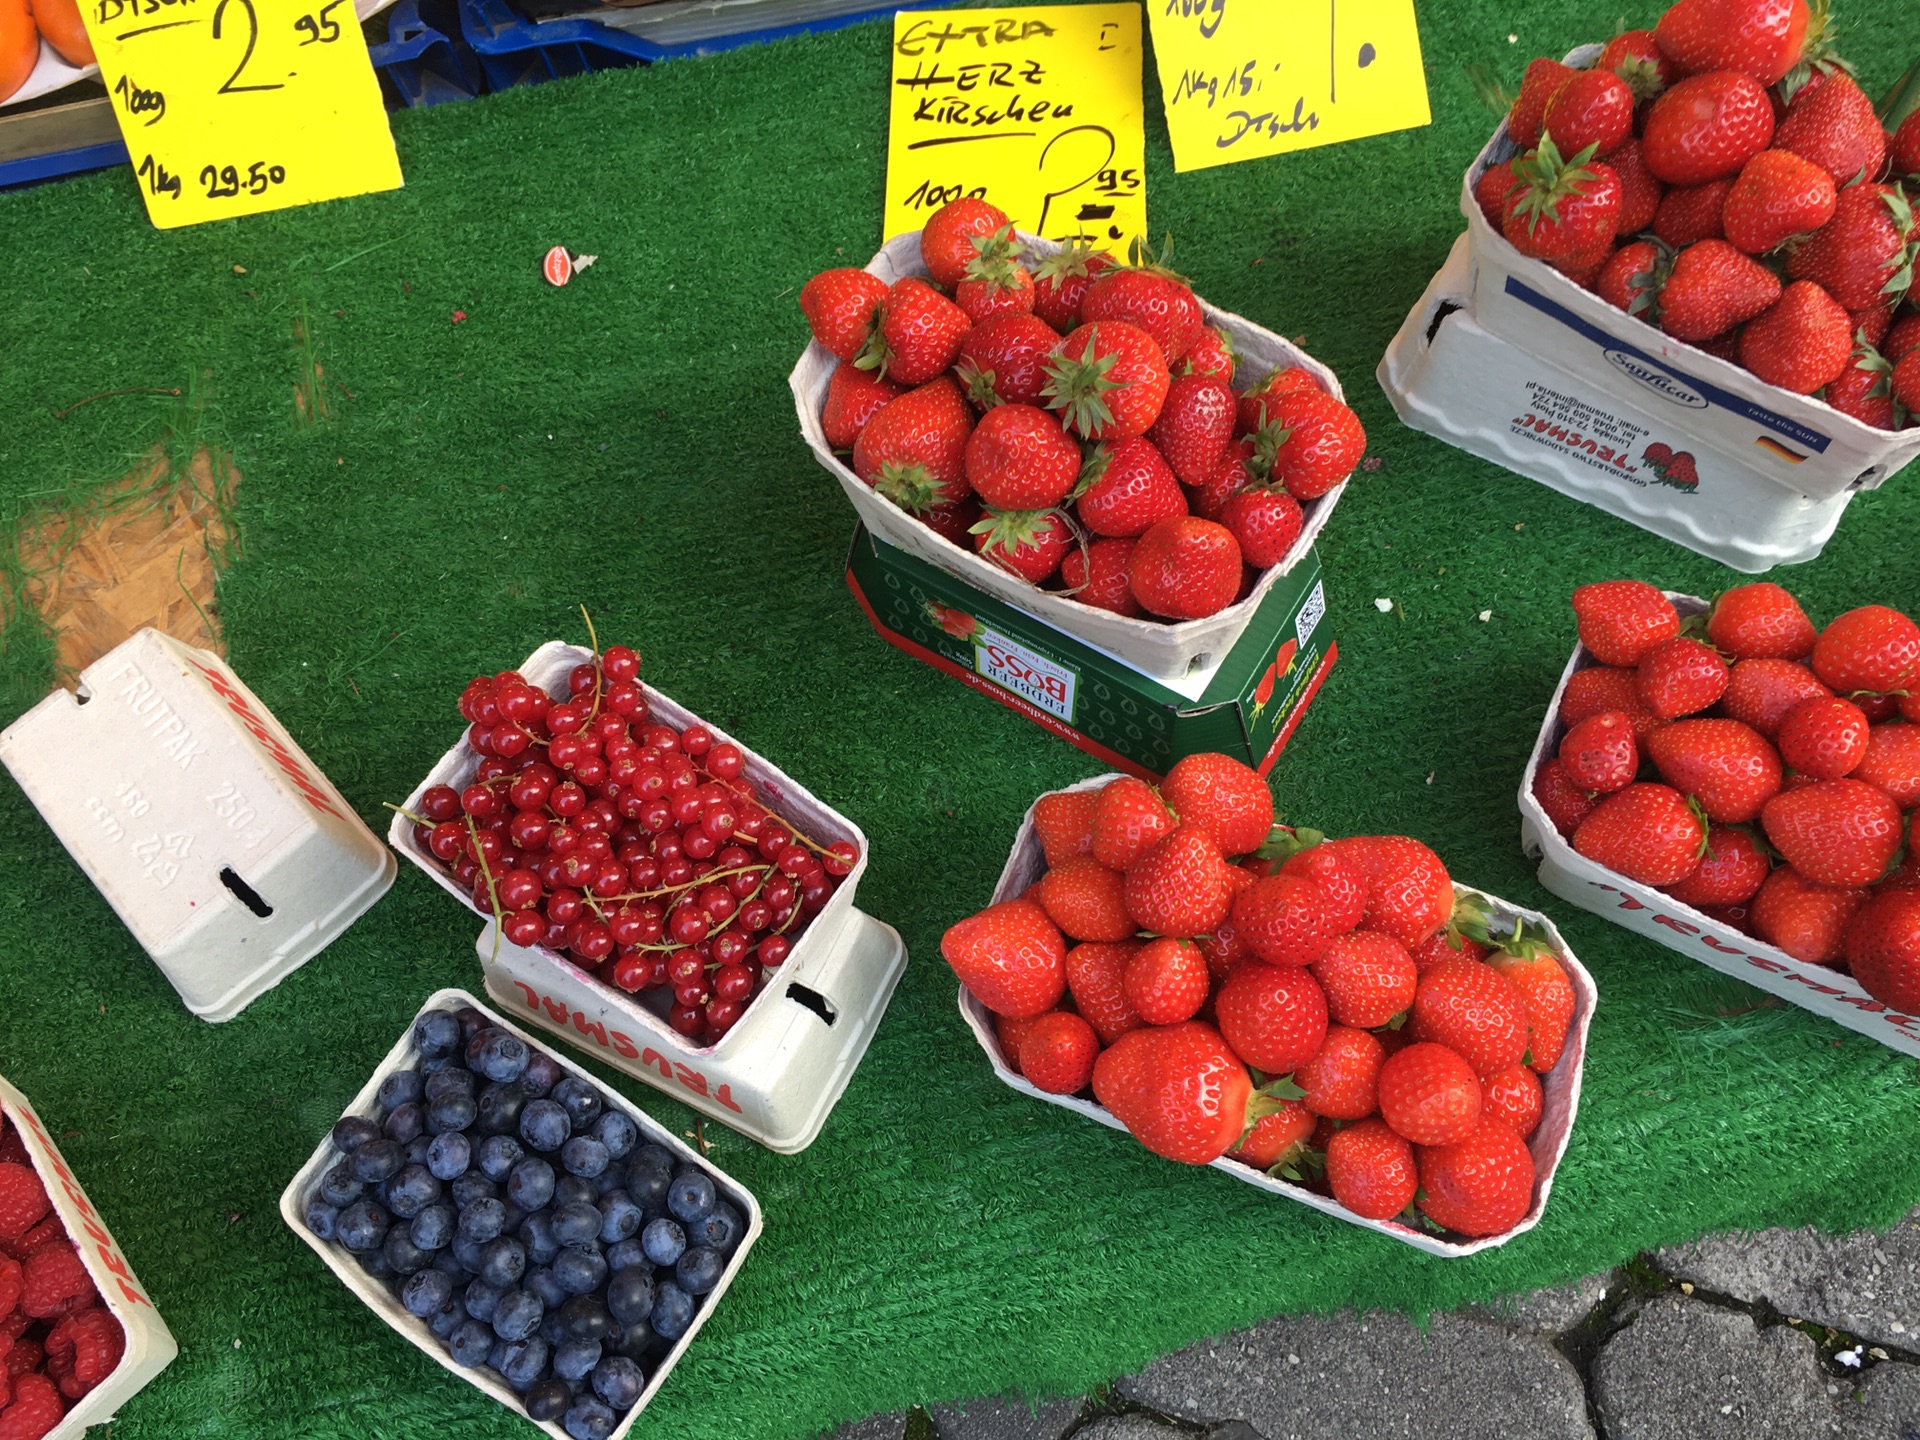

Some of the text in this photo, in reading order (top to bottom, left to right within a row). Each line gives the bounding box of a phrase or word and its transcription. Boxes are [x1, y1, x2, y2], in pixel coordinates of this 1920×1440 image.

[896, 19, 1057, 56] EXTRA
[896, 60, 1046, 91] HERZ
[138, 154, 285, 200] 1kg 29.50
[1532, 392, 1549, 406] 724
[1572, 409, 1590, 422] 509
[1557, 413, 1589, 431] 72-310
[1593, 418, 1617, 433] 0048
[1776, 419, 1794, 433] the
[1795, 426, 1818, 444] SUN
[1509, 424, 1648, 488] GOSPODARSTWO SADOWNICZE
[987, 644, 1067, 704] BOSS
[988, 664, 1065, 714] ERDBEER
[108, 661, 206, 770] FRUTPAK
[965, 672, 1081, 741] www.erdbeer-boss.de
[86, 797, 126, 842] ccm
[513, 980, 743, 1114] TRUSMAL
